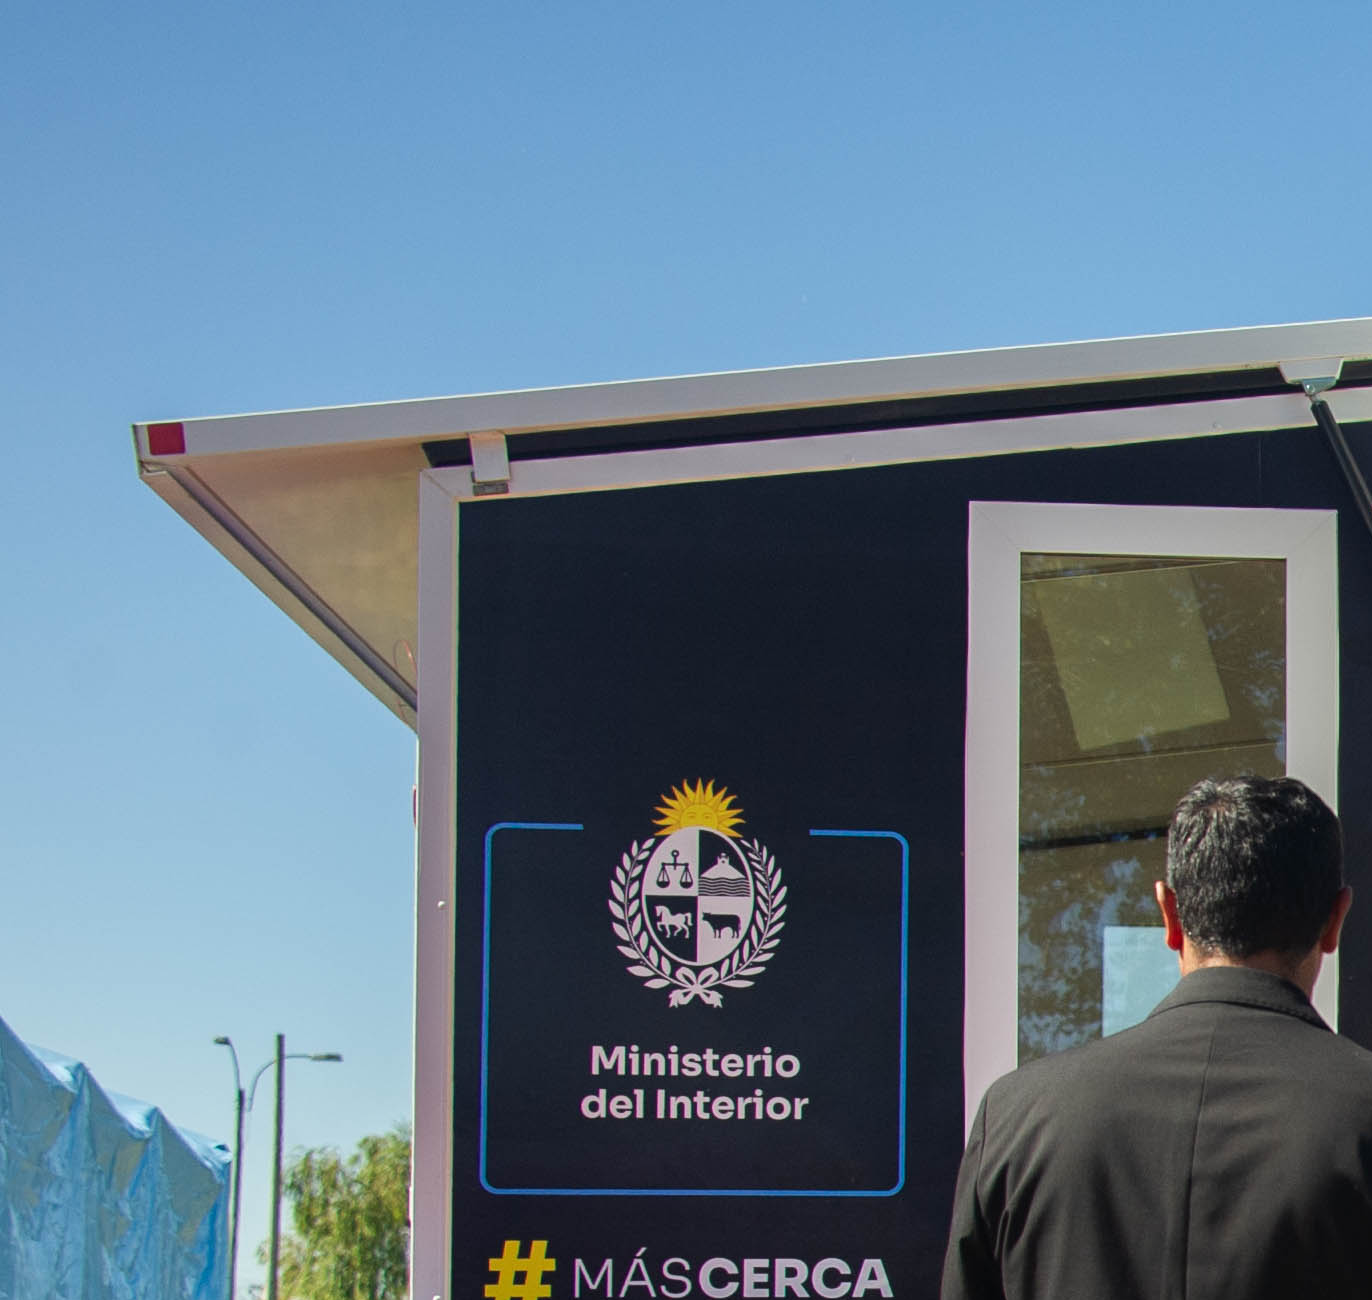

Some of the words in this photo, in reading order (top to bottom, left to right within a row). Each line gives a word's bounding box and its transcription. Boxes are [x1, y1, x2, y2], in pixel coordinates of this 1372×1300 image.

[591, 1045, 801, 1079] Ministerio
[580, 1089, 645, 1120] del
[656, 1090, 810, 1120] Interior
